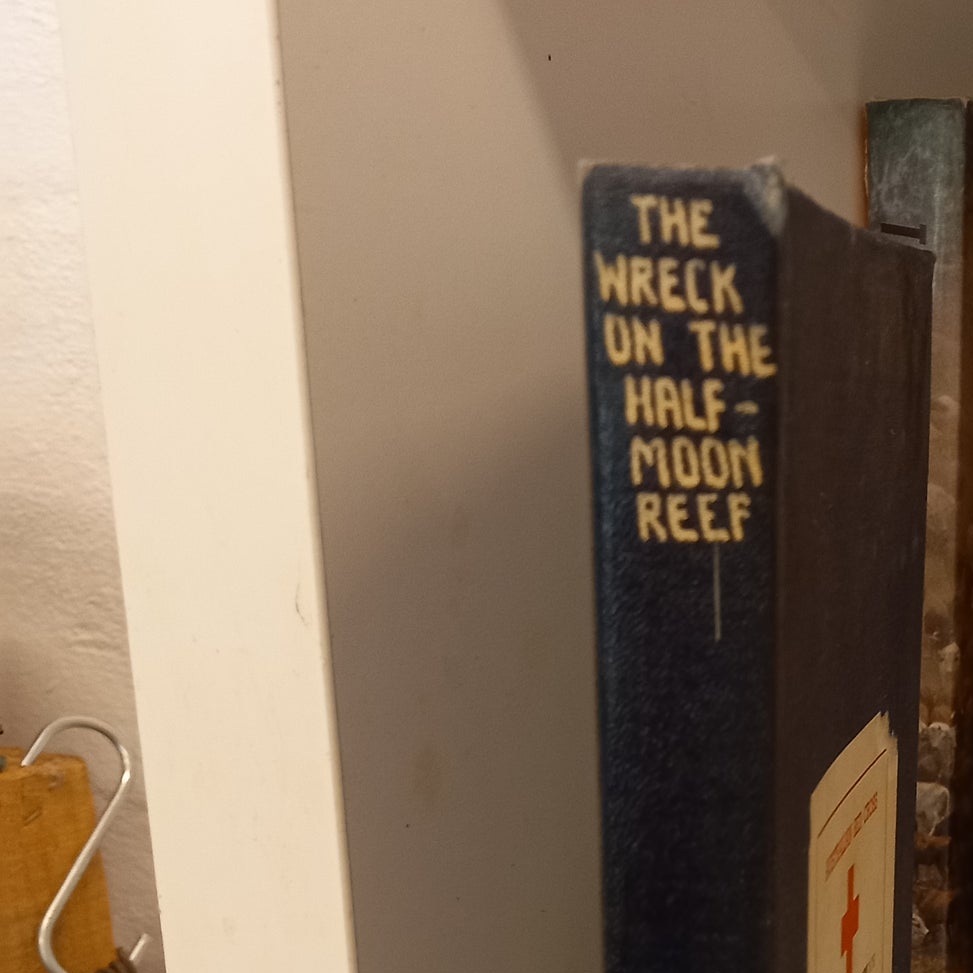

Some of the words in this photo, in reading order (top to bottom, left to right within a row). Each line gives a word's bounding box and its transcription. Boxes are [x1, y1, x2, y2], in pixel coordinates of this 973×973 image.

[631, 194, 720, 249] THE
[593, 253, 743, 315] WRECK
[604, 314, 664, 366] ON
[689, 320, 777, 378] THE
[624, 374, 759, 432] HALF-
[630, 436, 763, 489] MOON
[636, 492, 751, 543] REEF
